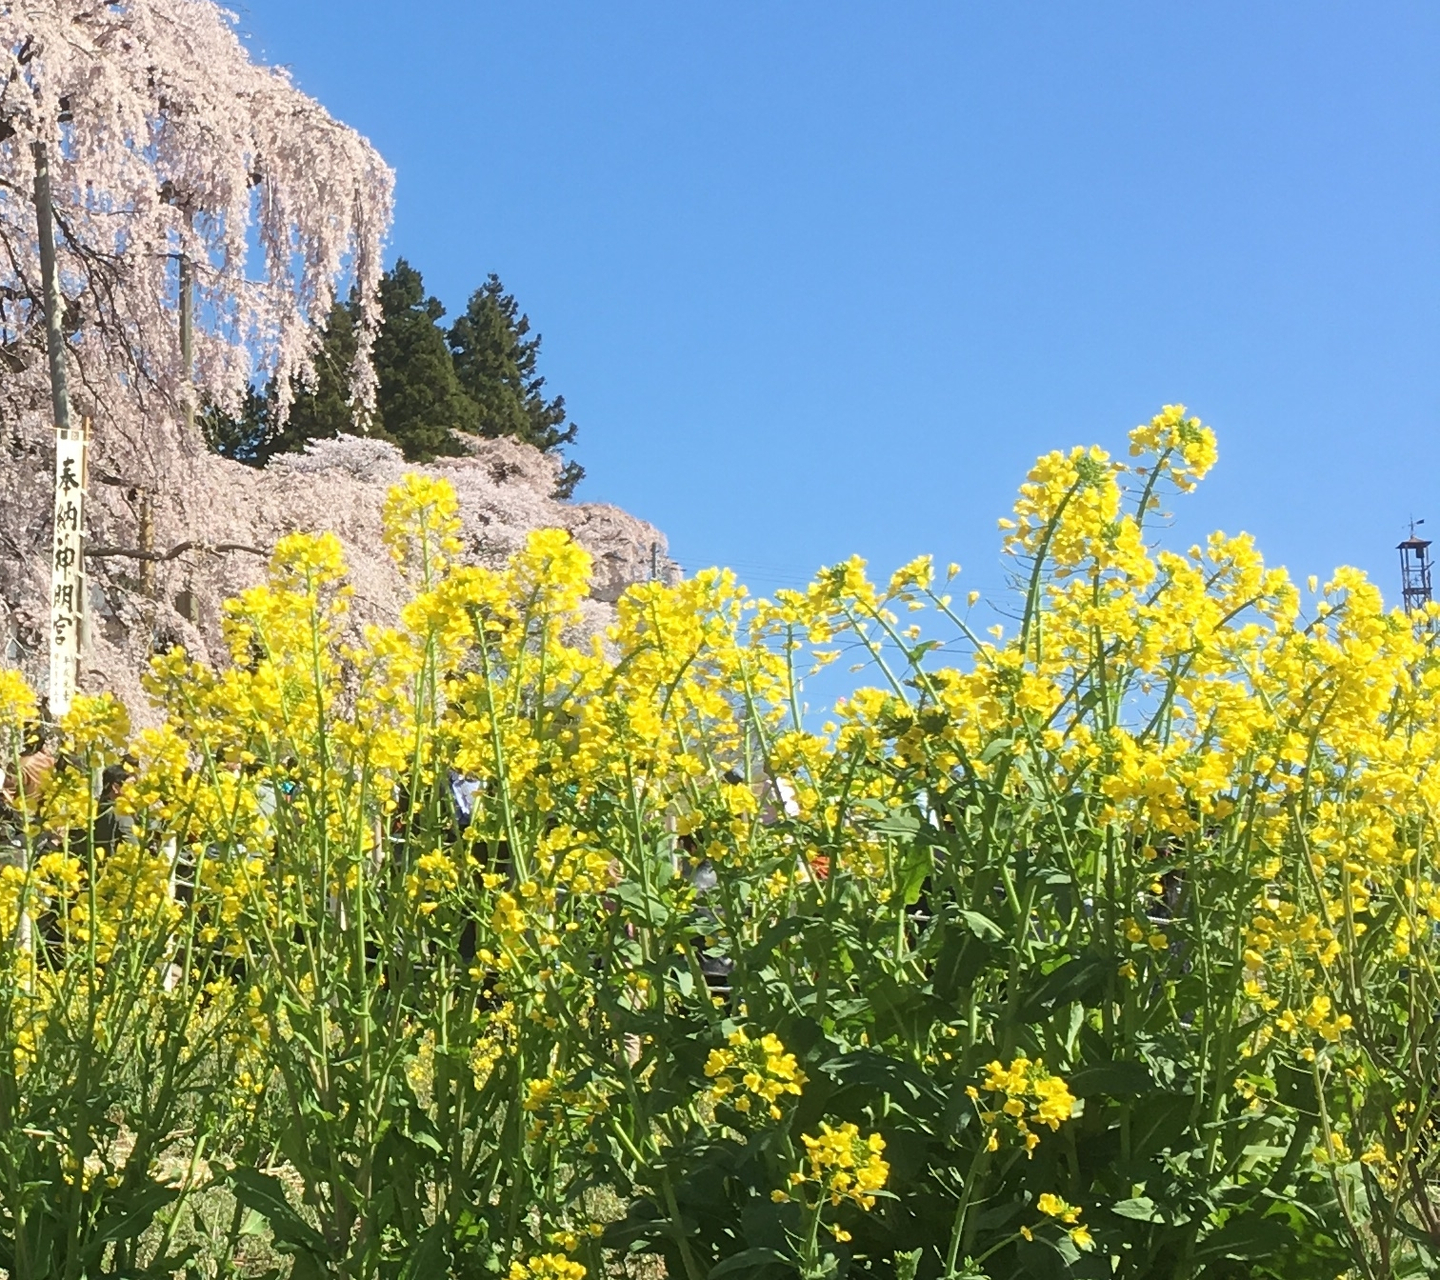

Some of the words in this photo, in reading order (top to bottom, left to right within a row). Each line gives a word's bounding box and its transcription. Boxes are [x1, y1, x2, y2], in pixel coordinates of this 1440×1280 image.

[53, 456, 79, 645] 奉納神明宮
